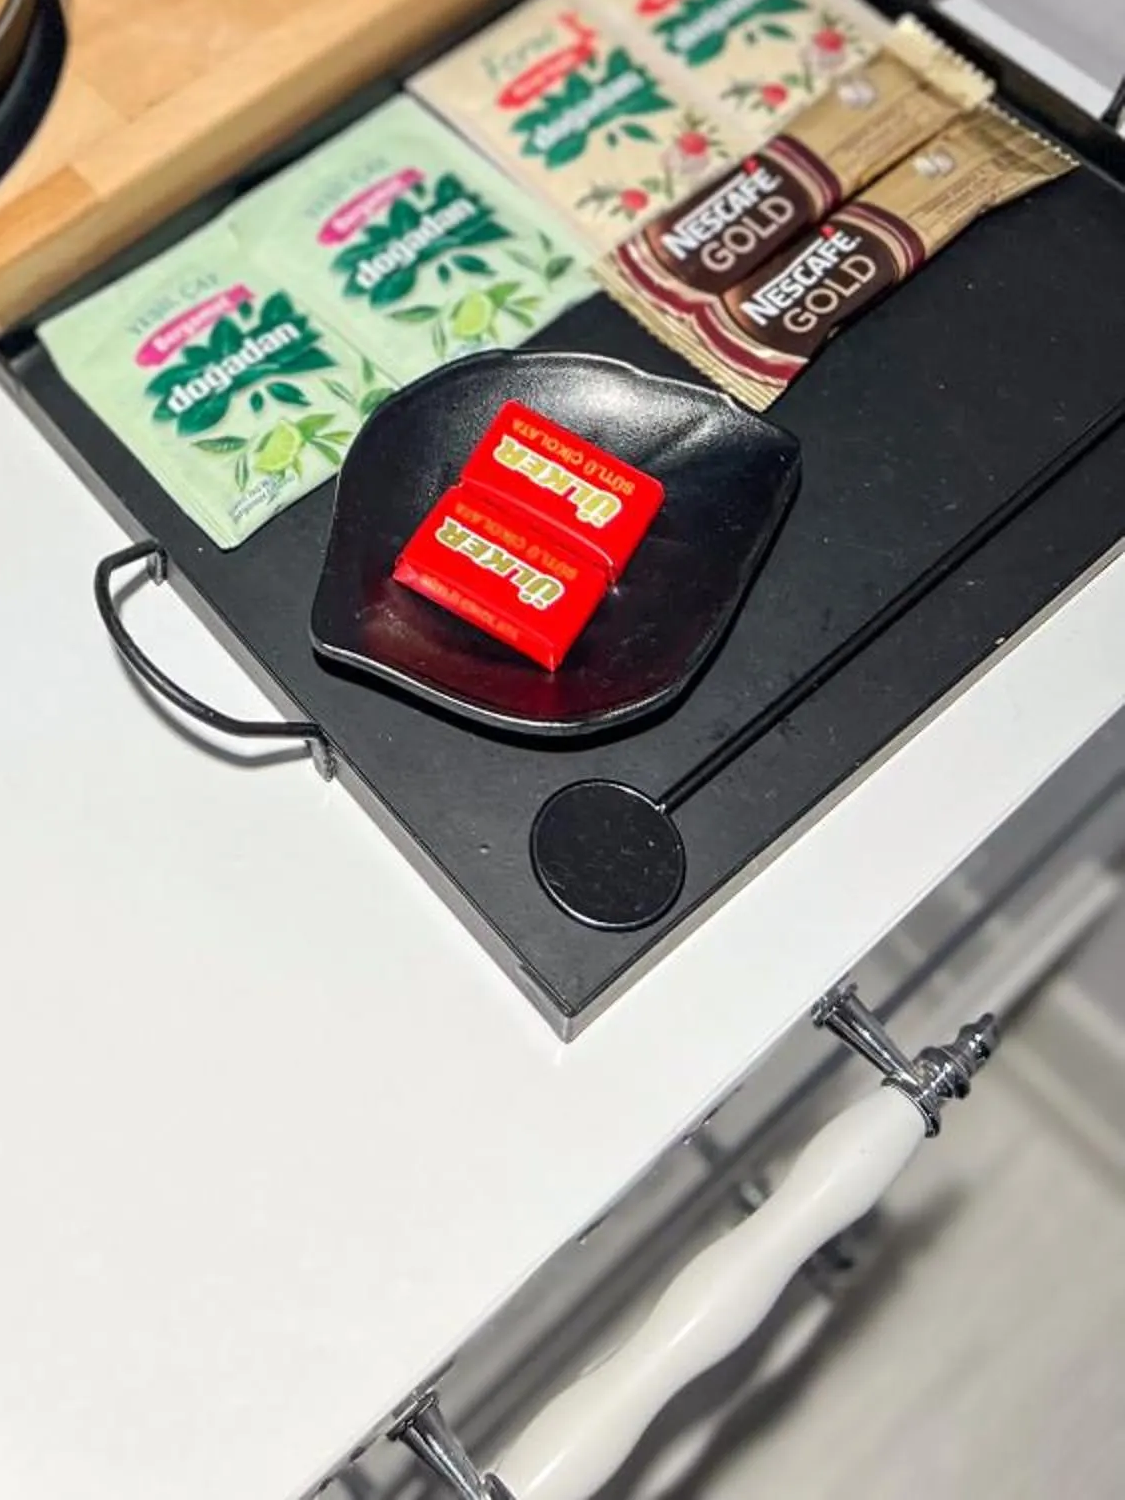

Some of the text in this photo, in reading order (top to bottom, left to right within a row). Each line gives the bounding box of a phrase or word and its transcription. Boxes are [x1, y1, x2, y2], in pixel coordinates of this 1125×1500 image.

[701, 196, 795, 272] GOLD
[783, 254, 876, 333] GOLD
[492, 434, 623, 529] ÜLKER
[435, 516, 565, 610] ÜLKER
